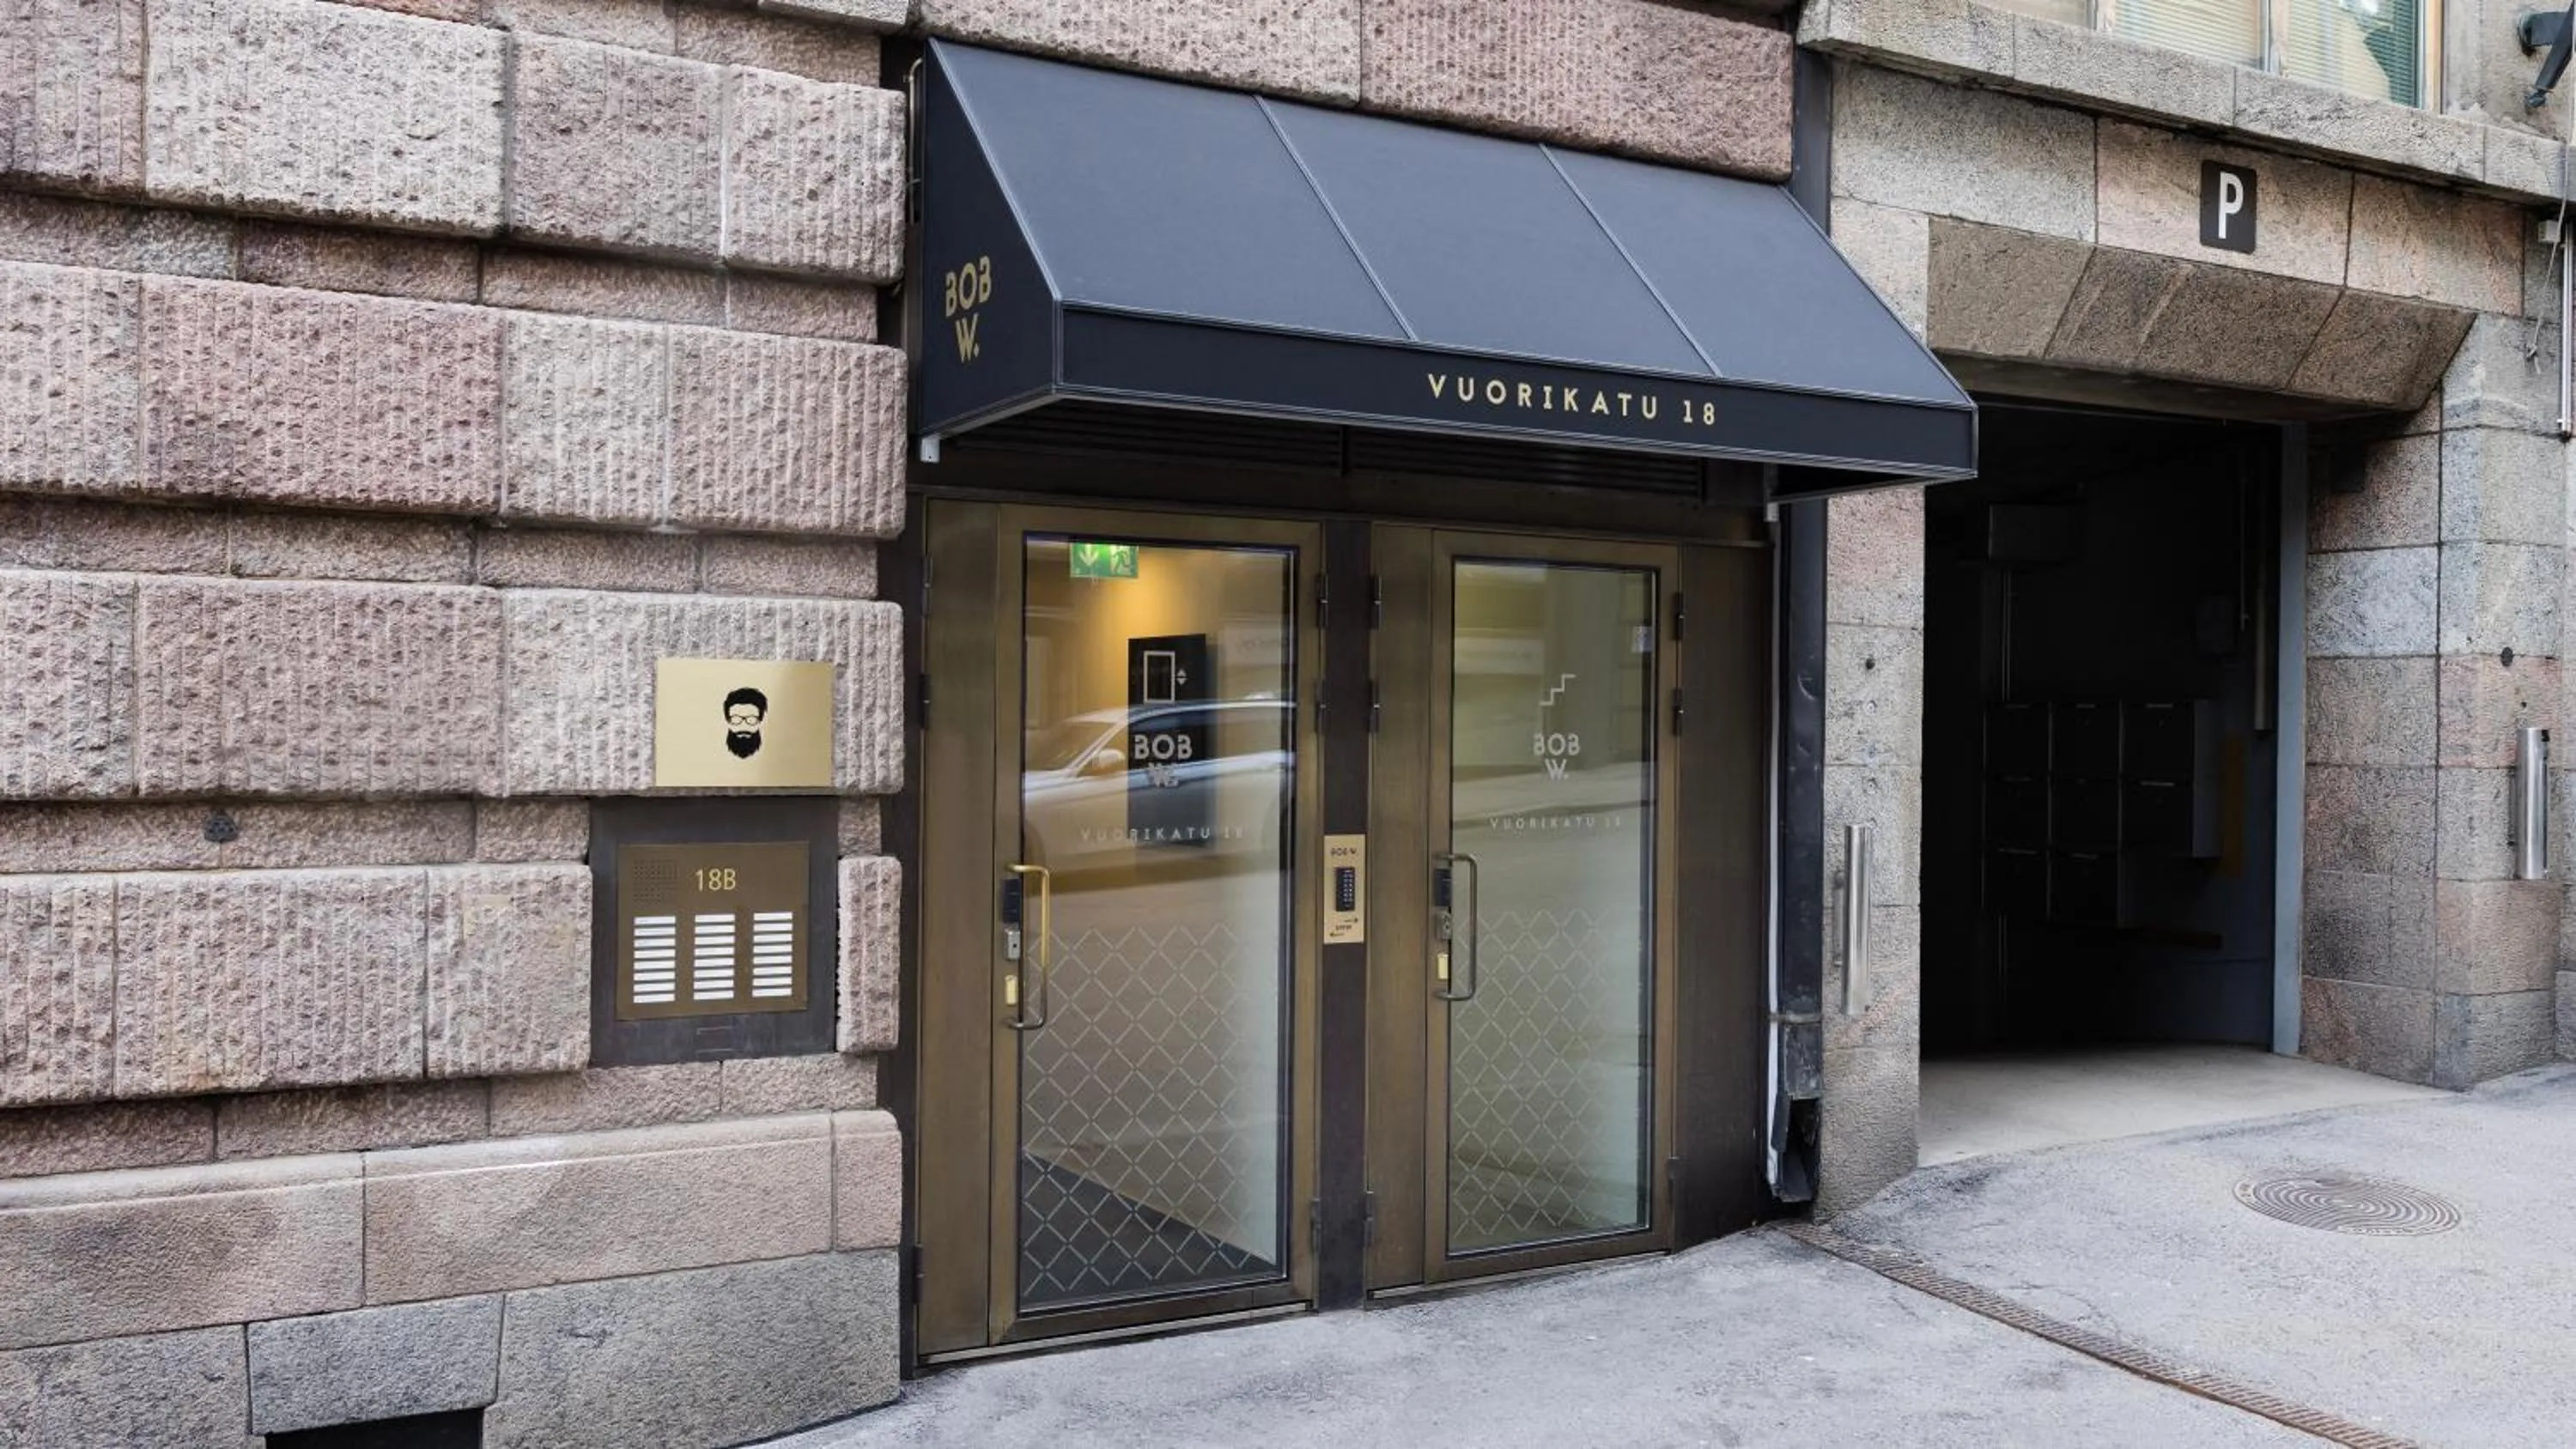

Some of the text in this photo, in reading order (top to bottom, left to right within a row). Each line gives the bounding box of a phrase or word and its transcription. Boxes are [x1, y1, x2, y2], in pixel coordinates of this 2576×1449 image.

[2218, 172, 2244, 239] P
[945, 256, 992, 318] BOB
[955, 312, 980, 363] W.
[1428, 373, 1716, 426] VUORIKATU 18
[1134, 734, 1193, 760] BOB
[1533, 732, 1581, 756] BOB
[1079, 826, 1211, 842] VUORIKATU
[696, 868, 737, 892] 18B
